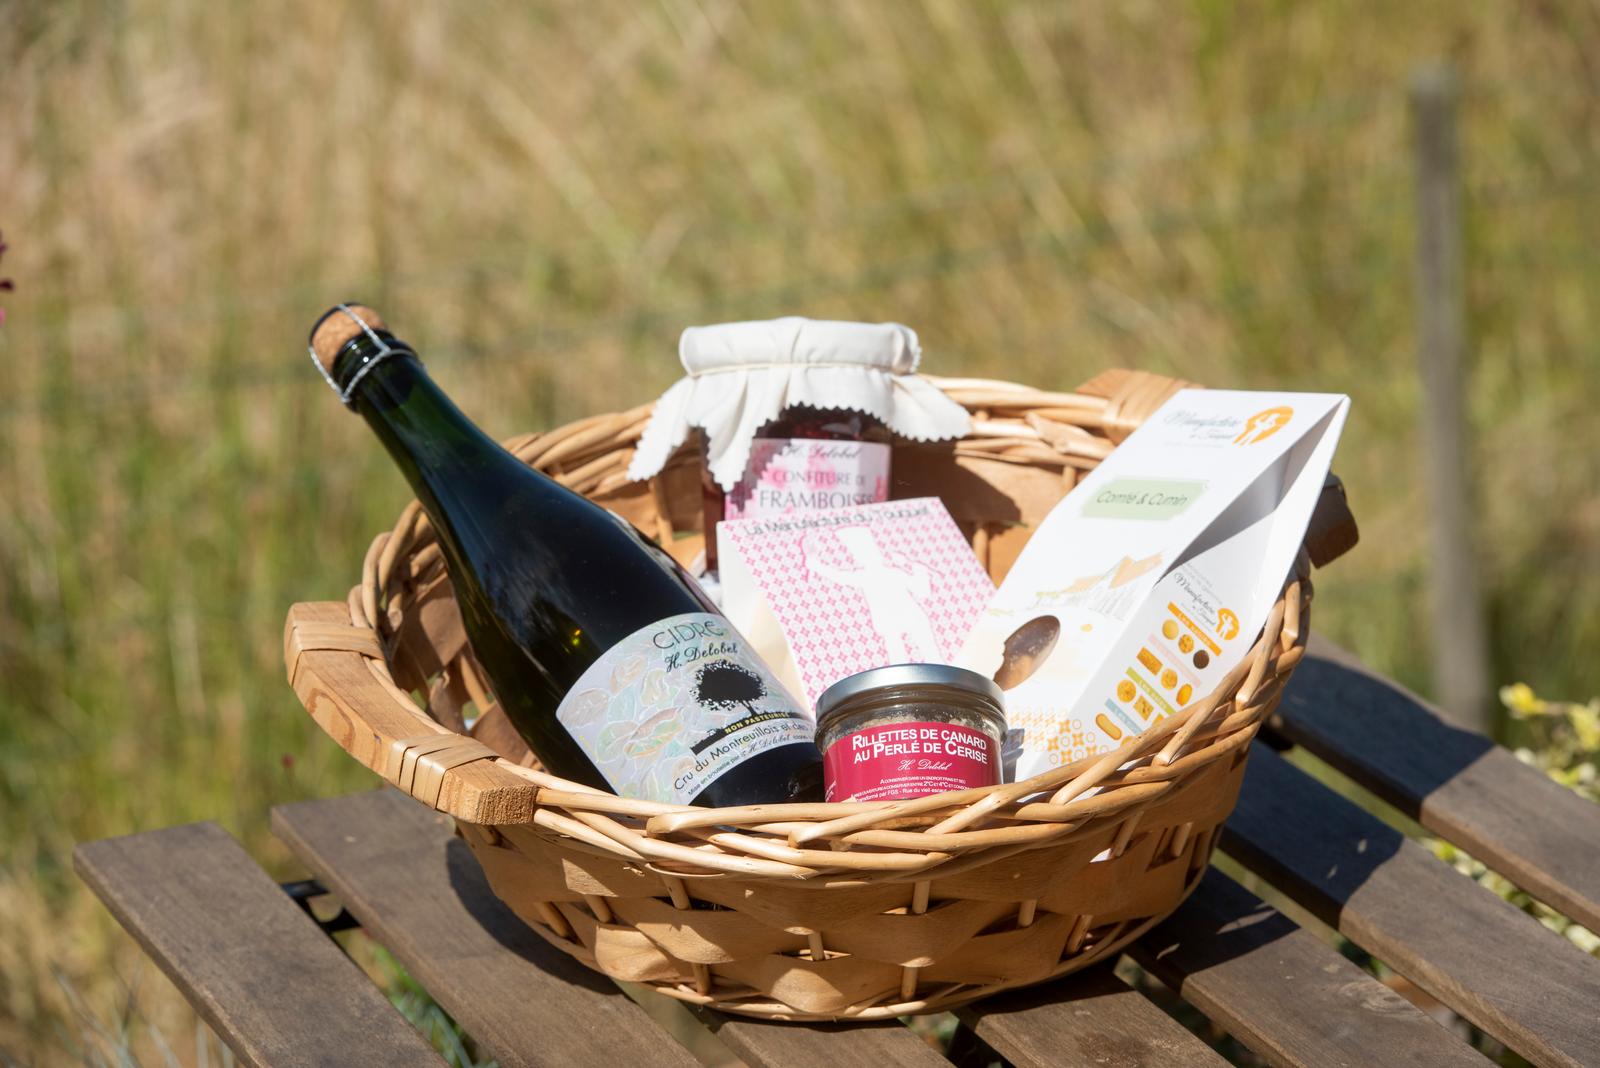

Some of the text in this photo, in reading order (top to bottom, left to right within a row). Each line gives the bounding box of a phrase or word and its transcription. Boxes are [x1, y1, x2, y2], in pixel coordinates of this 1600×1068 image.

[773, 470, 851, 485] CONFITURE
[1097, 490, 1188, 506] Comté & Cumin
[744, 506, 929, 535] La Manufacture du Touquet
[653, 620, 724, 649] CIDRE
[664, 641, 738, 673] H. Delobel
[724, 722, 744, 734] NON
[852, 728, 987, 751] RILLETTES DE CANARD
[674, 771, 694, 790] Cru
[695, 758, 709, 773] du
[710, 726, 780, 761] Montreuillois
[853, 740, 988, 765] AU PERLÉ DE CERISE
[917, 758, 953, 771] Delobel
[688, 783, 701, 796] Mise
[701, 775, 708, 784] en
[708, 760, 731, 779] bouteille
[923, 780, 934, 788] 2°C
[939, 781, 949, 789] 4°C
[879, 791, 887, 799] par
[887, 788, 900, 796] FGS
